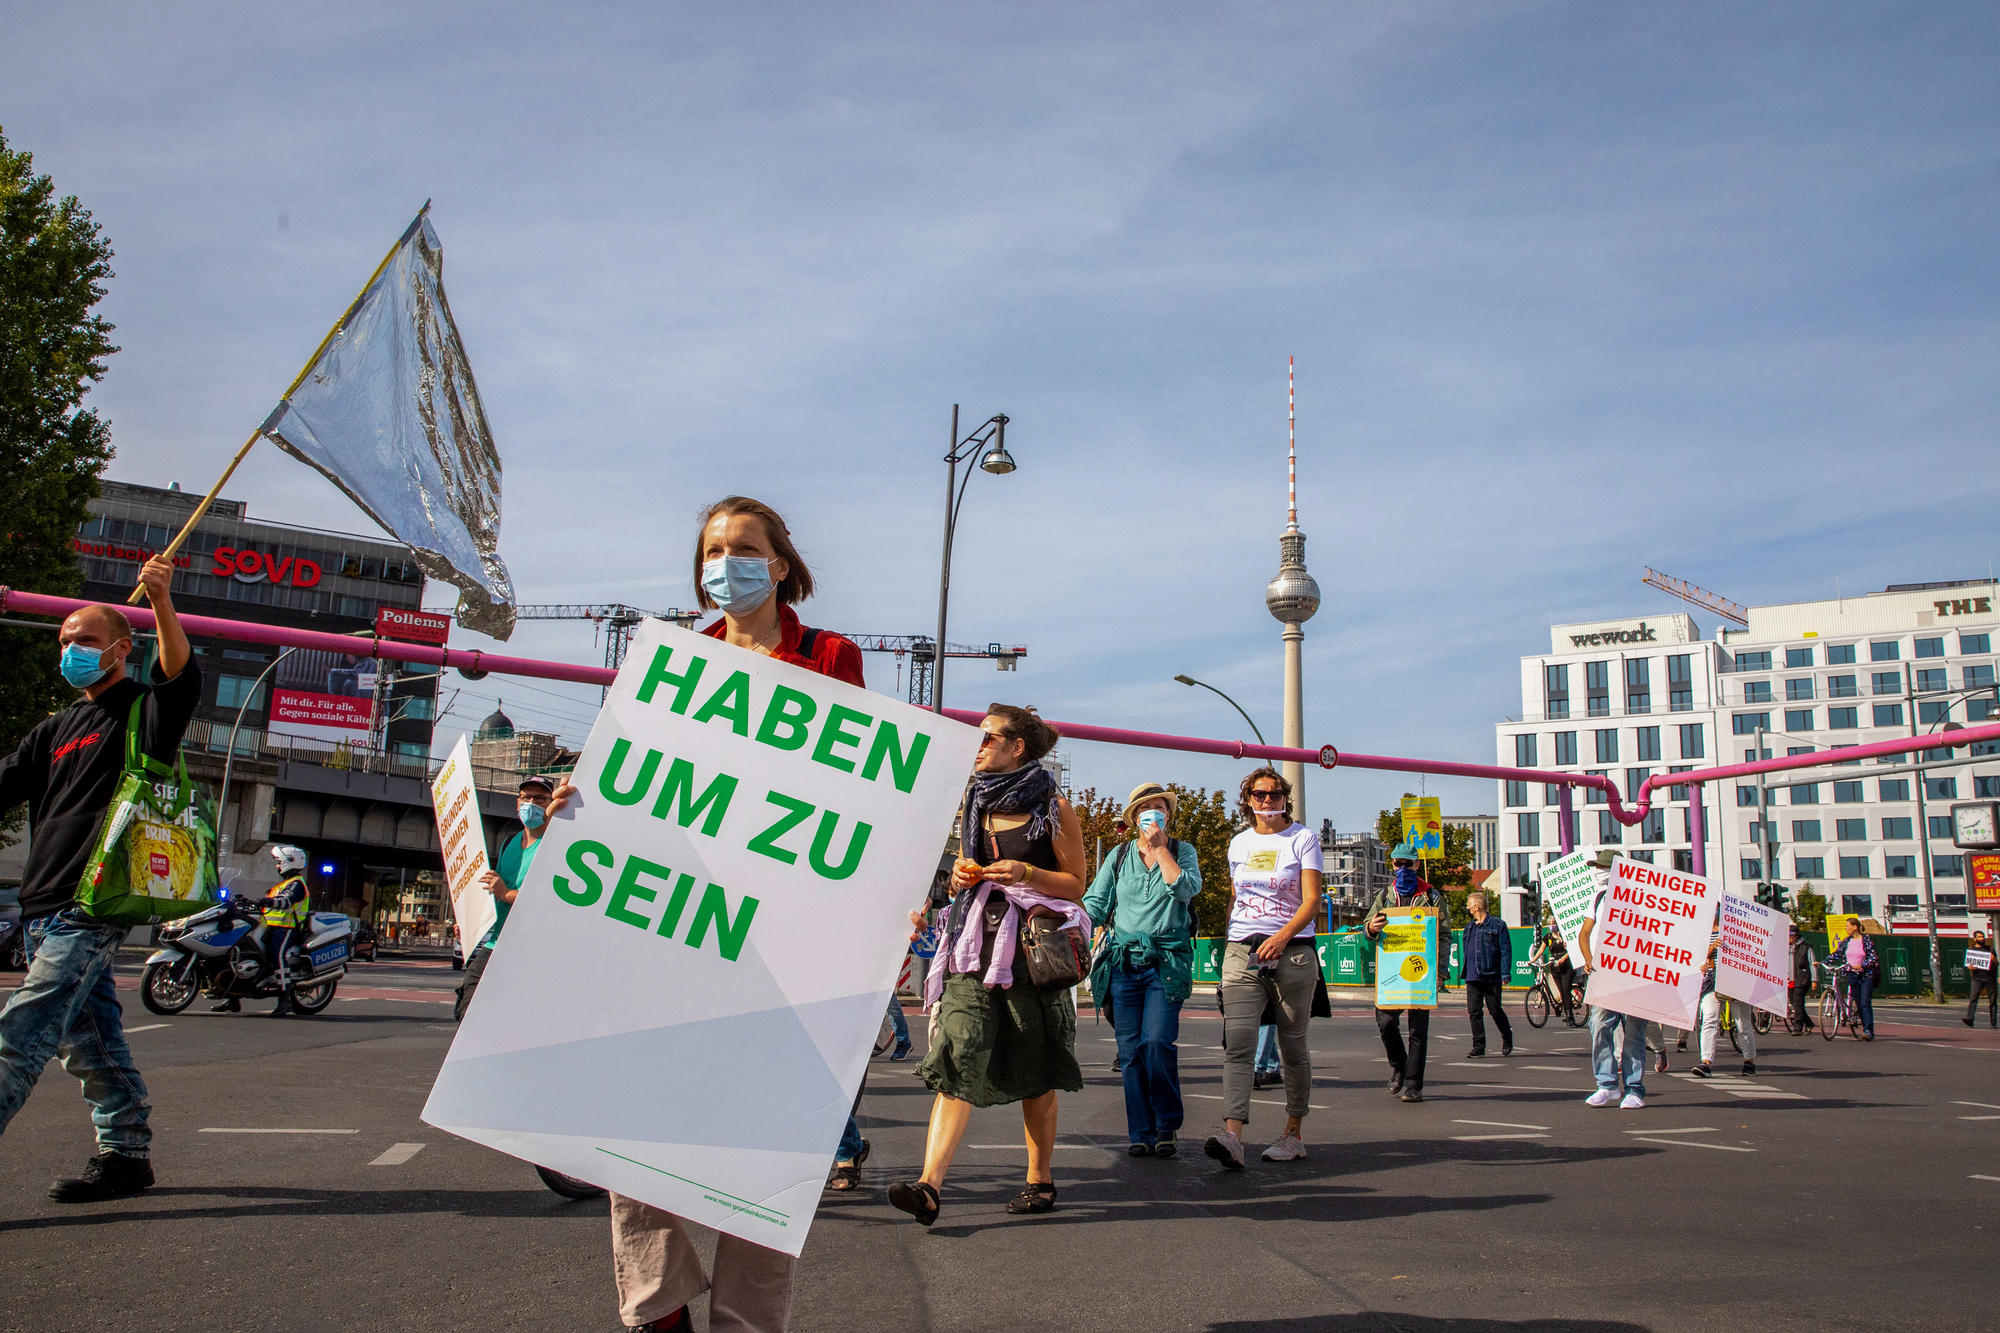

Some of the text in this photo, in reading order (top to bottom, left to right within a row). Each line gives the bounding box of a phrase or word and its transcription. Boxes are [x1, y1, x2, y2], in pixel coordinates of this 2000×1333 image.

[1933, 596, 1992, 616] THE
[382, 610, 446, 629] Pollems
[1569, 621, 1657, 648] wework
[279, 707, 309, 718] Gegen
[311, 711, 345, 722] soziale
[280, 696, 357, 712] Mit dir. Für alle.
[635, 644, 931, 794] HABEN
[440, 786, 470, 838] GRUNDEIN-
[599, 737, 873, 881] UM ZU
[444, 814, 469, 862] KOMMEN
[448, 844, 468, 884] MACHT
[1542, 853, 1584, 878] EINE BLUME
[452, 850, 484, 904] ZUFRIEDENER
[1269, 877, 1297, 891] BGE
[1546, 864, 1591, 889] GIESST MAN
[1550, 875, 1592, 899] DOCH AUCH
[1619, 863, 1707, 898] WENIGER
[552, 839, 760, 963] SEIN
[1553, 894, 1575, 910] NICHT
[1557, 905, 1579, 920] WENN
[1613, 885, 1696, 919] MÜSSEN
[1724, 904, 1750, 920] ZEIGT:
[1725, 895, 1769, 917] DIE PRAXIS
[1608, 907, 1675, 936] FÜHRT
[1724, 914, 1773, 937] GRUNDEIN-
[1565, 931, 1577, 942] IST
[1723, 924, 1763, 945] KOMMEN
[1723, 935, 1766, 957] FÜHRT ZU
[316, 946, 345, 964] POLIZEI
[1603, 930, 1693, 966] ZU MEHR
[1722, 945, 1768, 969] BESSEREN
[1340, 957, 1355, 968] ubm
[1408, 955, 1423, 973] LIFE
[1600, 953, 1680, 987] WOLLEN
[1721, 956, 1784, 986] BEZIEHUNGEN
[1890, 964, 1907, 976] ubm
[1966, 957, 1990, 968] MONEY
